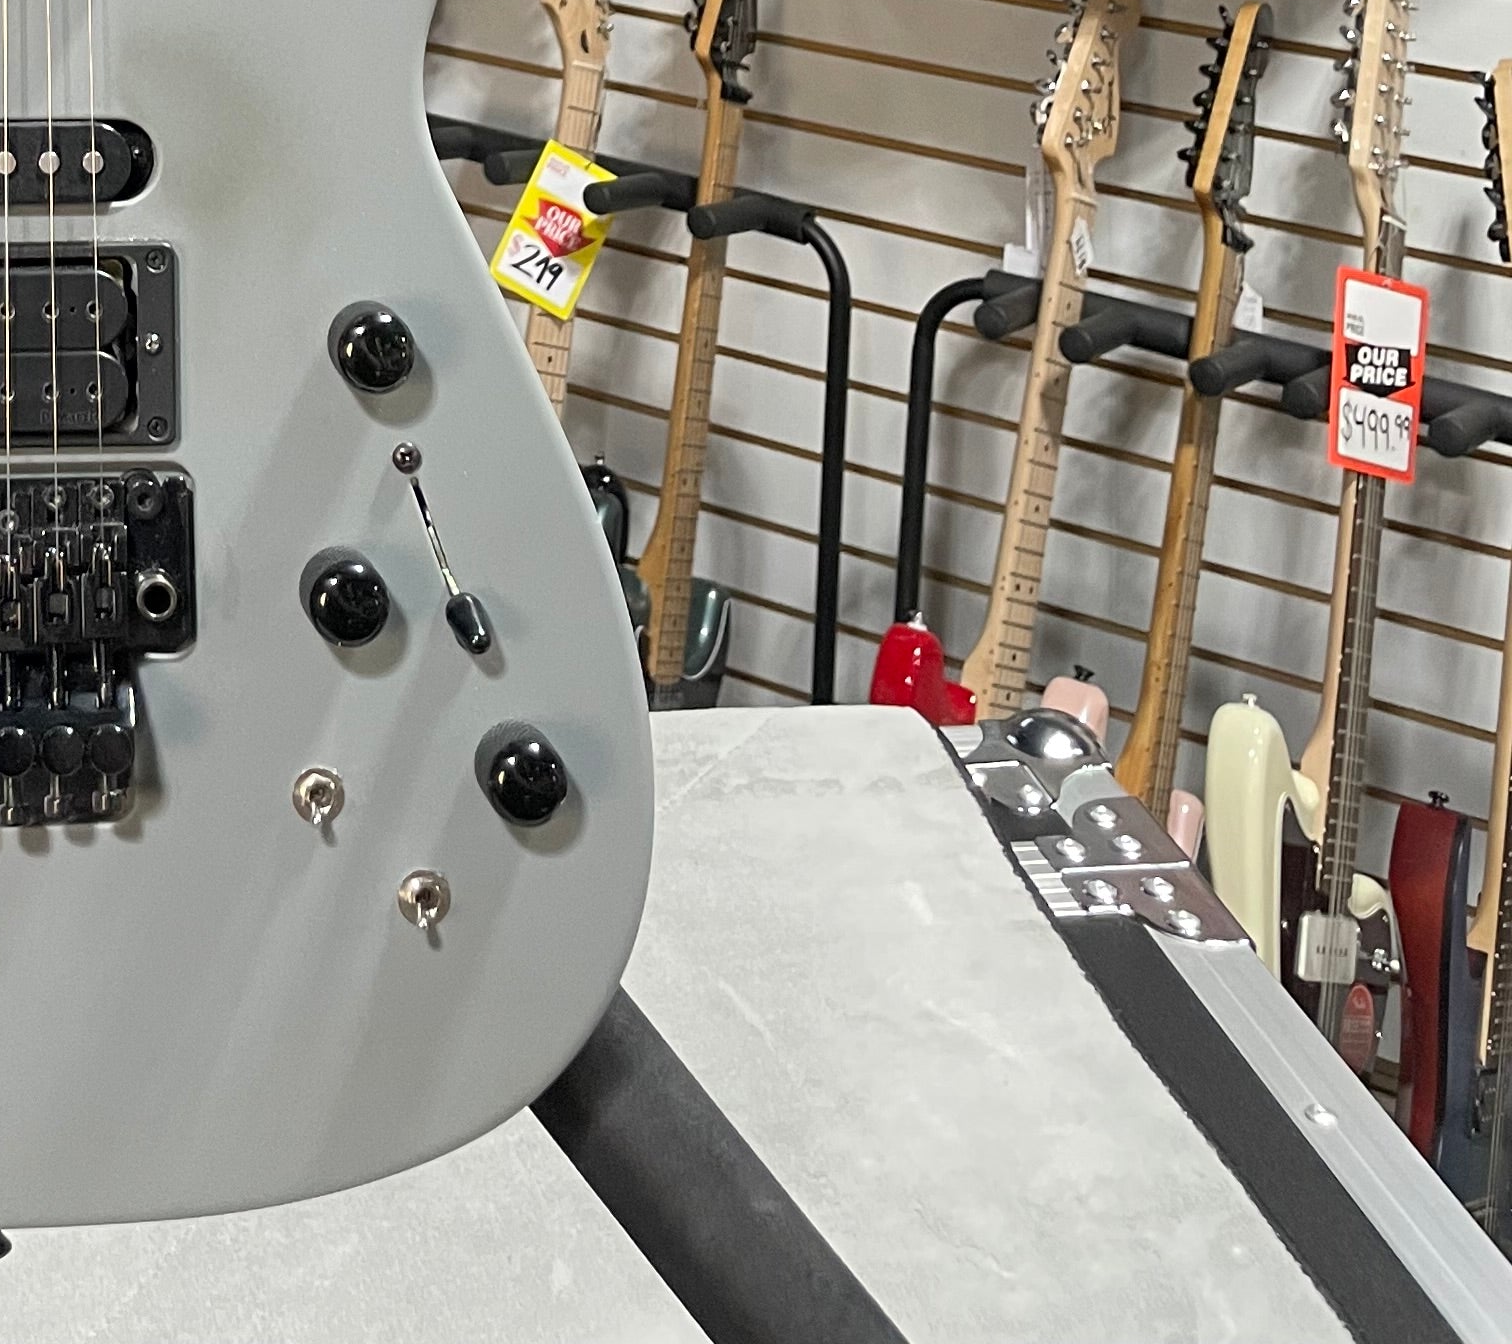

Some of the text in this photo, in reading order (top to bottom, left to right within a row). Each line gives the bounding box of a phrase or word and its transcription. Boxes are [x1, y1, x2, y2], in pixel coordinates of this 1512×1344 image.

[546, 205, 583, 234] OUR
[534, 216, 582, 251] PRICE
[1357, 346, 1400, 367] OUR
[1350, 365, 1408, 387] PRICE
